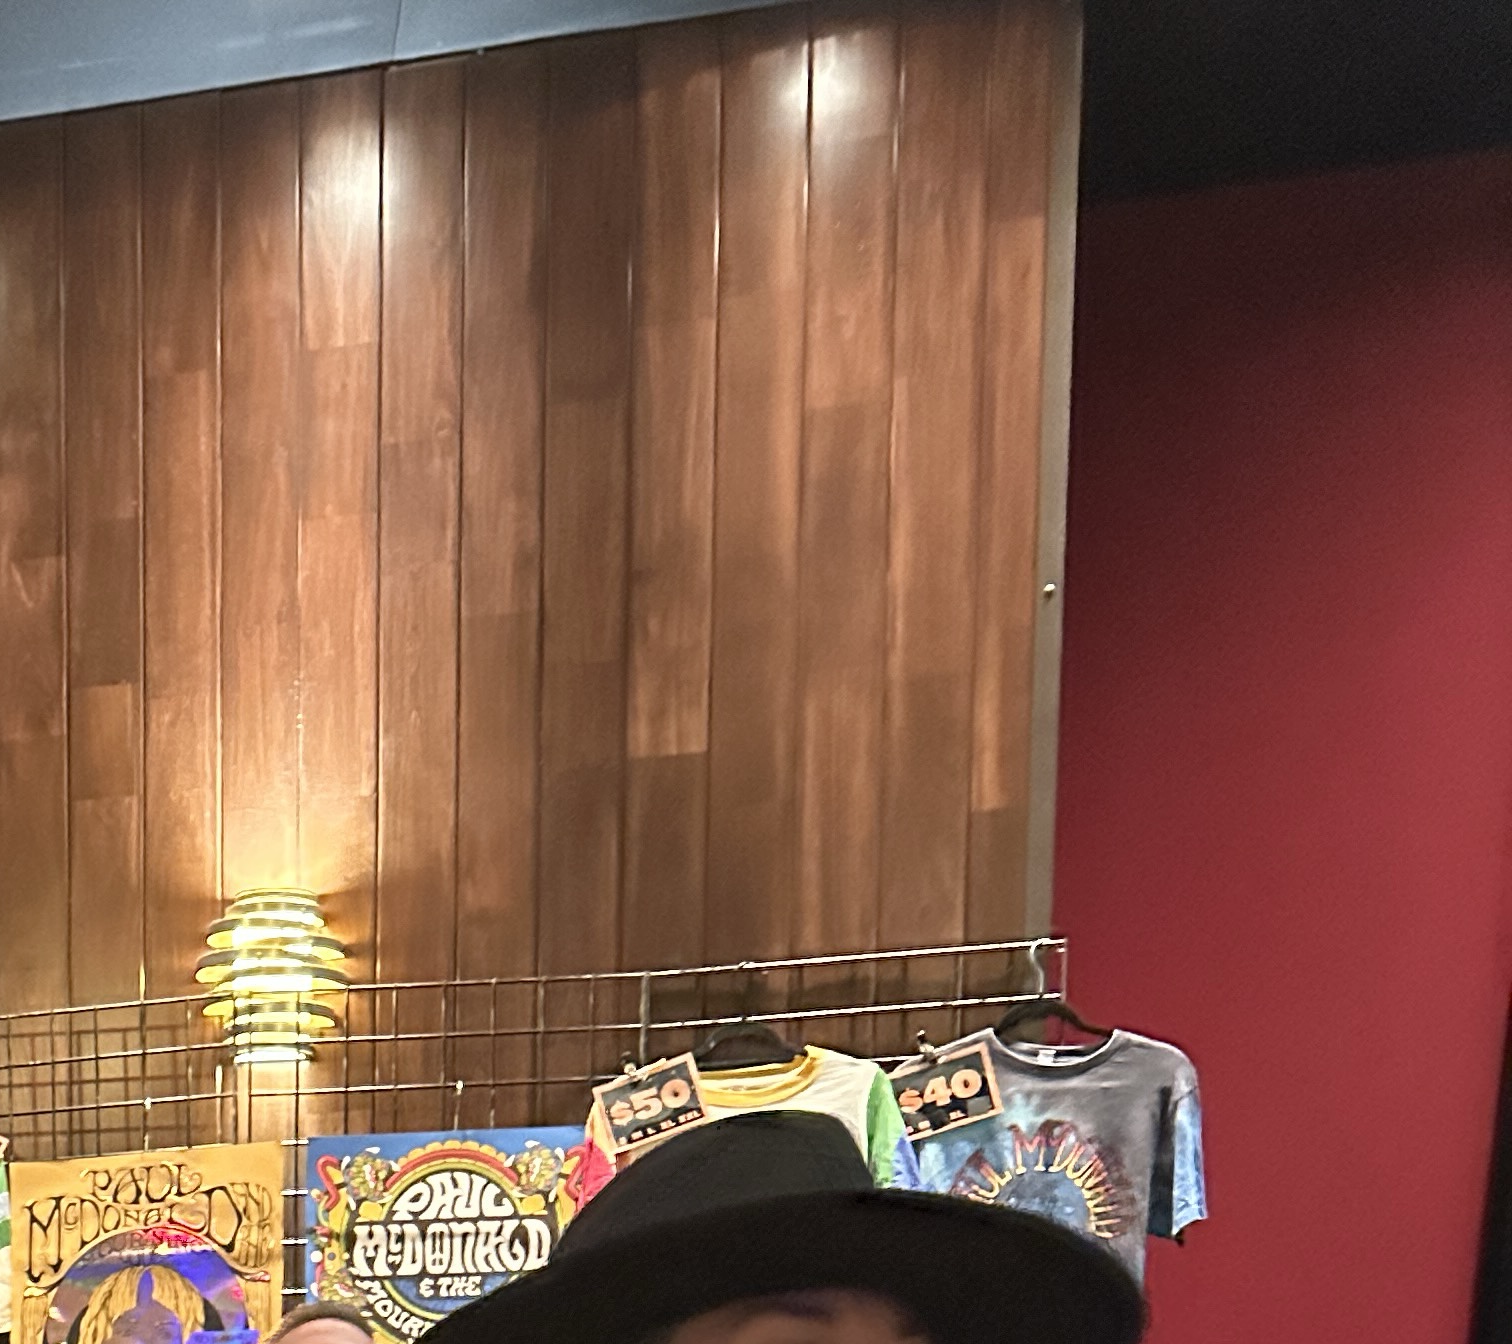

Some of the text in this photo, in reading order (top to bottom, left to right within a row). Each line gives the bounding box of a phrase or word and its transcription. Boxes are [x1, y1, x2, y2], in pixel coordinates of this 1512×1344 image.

[610, 1078, 690, 1126] $50
[898, 1068, 982, 1114] $40
[79, 1160, 204, 1205] PAUL
[391, 1170, 515, 1221] PAUL
[436, 1275, 483, 1297] THE
